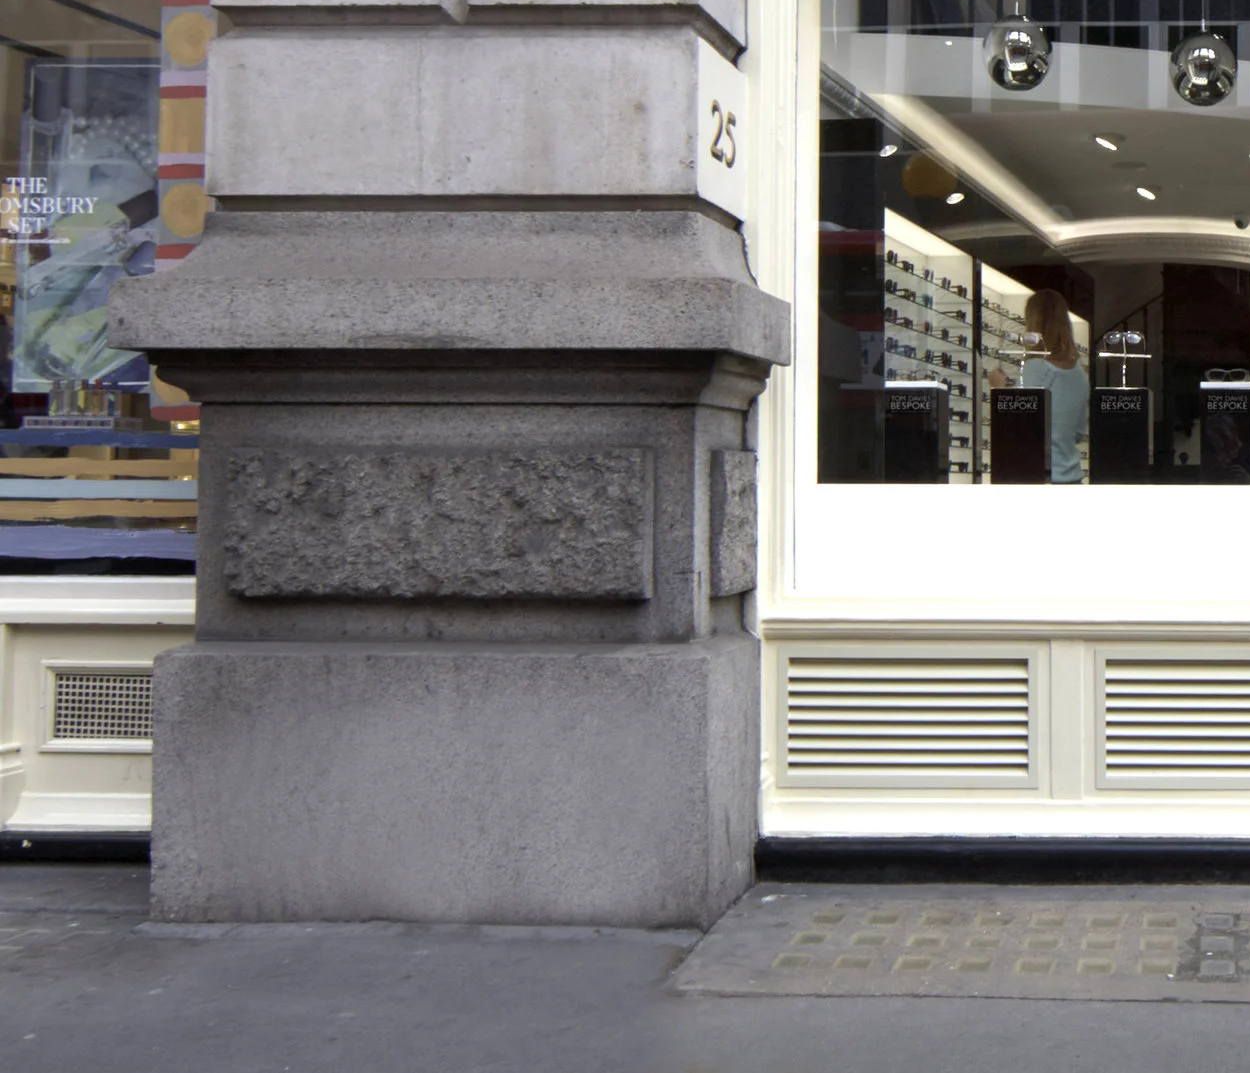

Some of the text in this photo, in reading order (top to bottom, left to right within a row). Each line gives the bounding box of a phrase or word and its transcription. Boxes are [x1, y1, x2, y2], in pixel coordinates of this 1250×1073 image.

[710, 99, 736, 169] 25
[7, 177, 48, 194] THE
[8, 217, 46, 234] SET
[891, 401, 931, 410] BESPOKE
[997, 401, 1038, 410] BESPOKE
[1101, 401, 1142, 410] BESPOKE
[1207, 401, 1248, 410] BESPOKE
